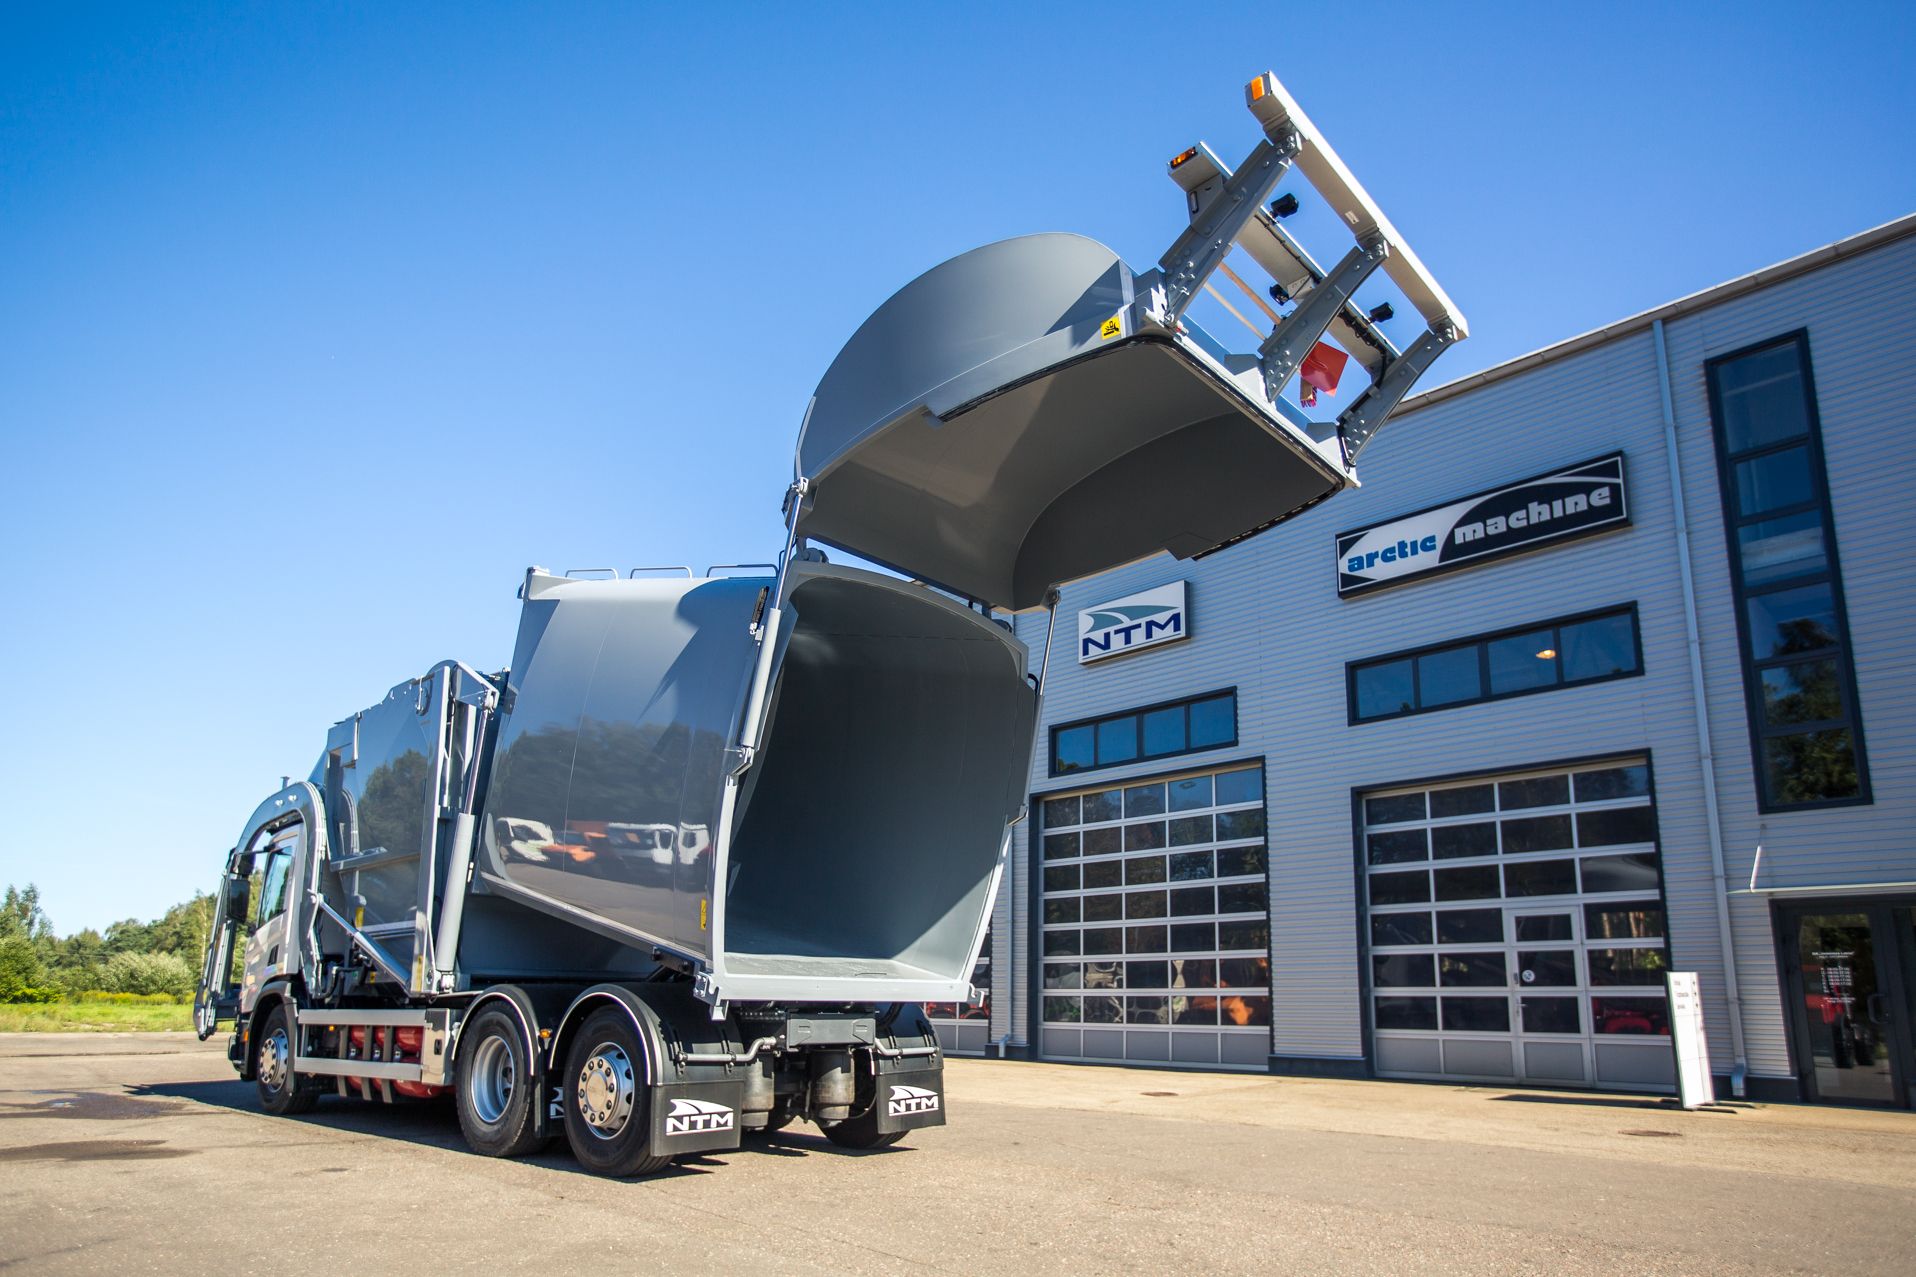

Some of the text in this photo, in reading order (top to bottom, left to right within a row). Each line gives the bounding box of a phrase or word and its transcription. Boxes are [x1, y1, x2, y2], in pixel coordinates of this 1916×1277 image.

[1347, 486, 1611, 572] arctic machine
[1082, 611, 1181, 657] NTM
[888, 1096, 939, 1114] NTM
[666, 1112, 733, 1133] NTM
